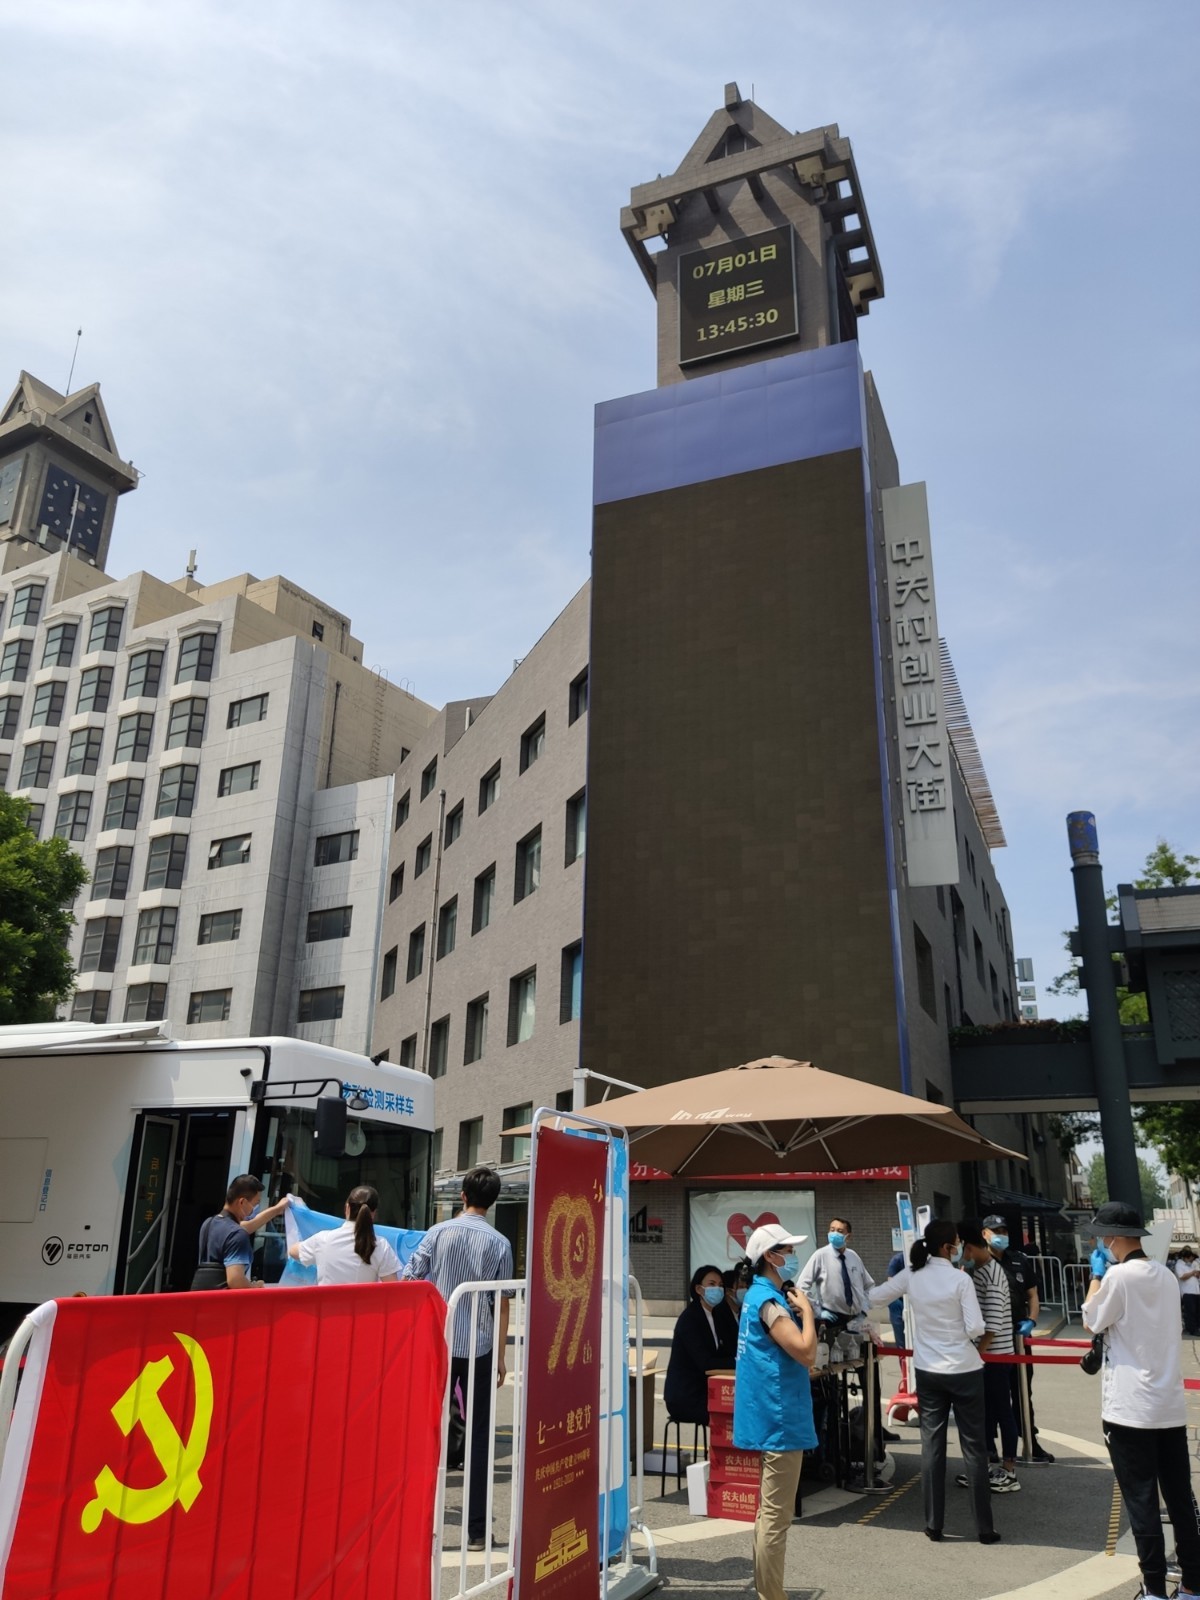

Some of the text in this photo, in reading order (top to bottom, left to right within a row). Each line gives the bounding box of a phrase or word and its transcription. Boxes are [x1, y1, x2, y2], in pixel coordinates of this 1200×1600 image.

[692, 244, 777, 279] 07月01日
[707, 279, 765, 309] 星期三
[697, 308, 779, 342] 13:45:30
[890, 535, 946, 813] 中关村创业大街
[67, 1243, 109, 1252] FOTON
[725, 1455, 760, 1467] 农夫山泉
[721, 1490, 756, 1504] 农夫山泉
